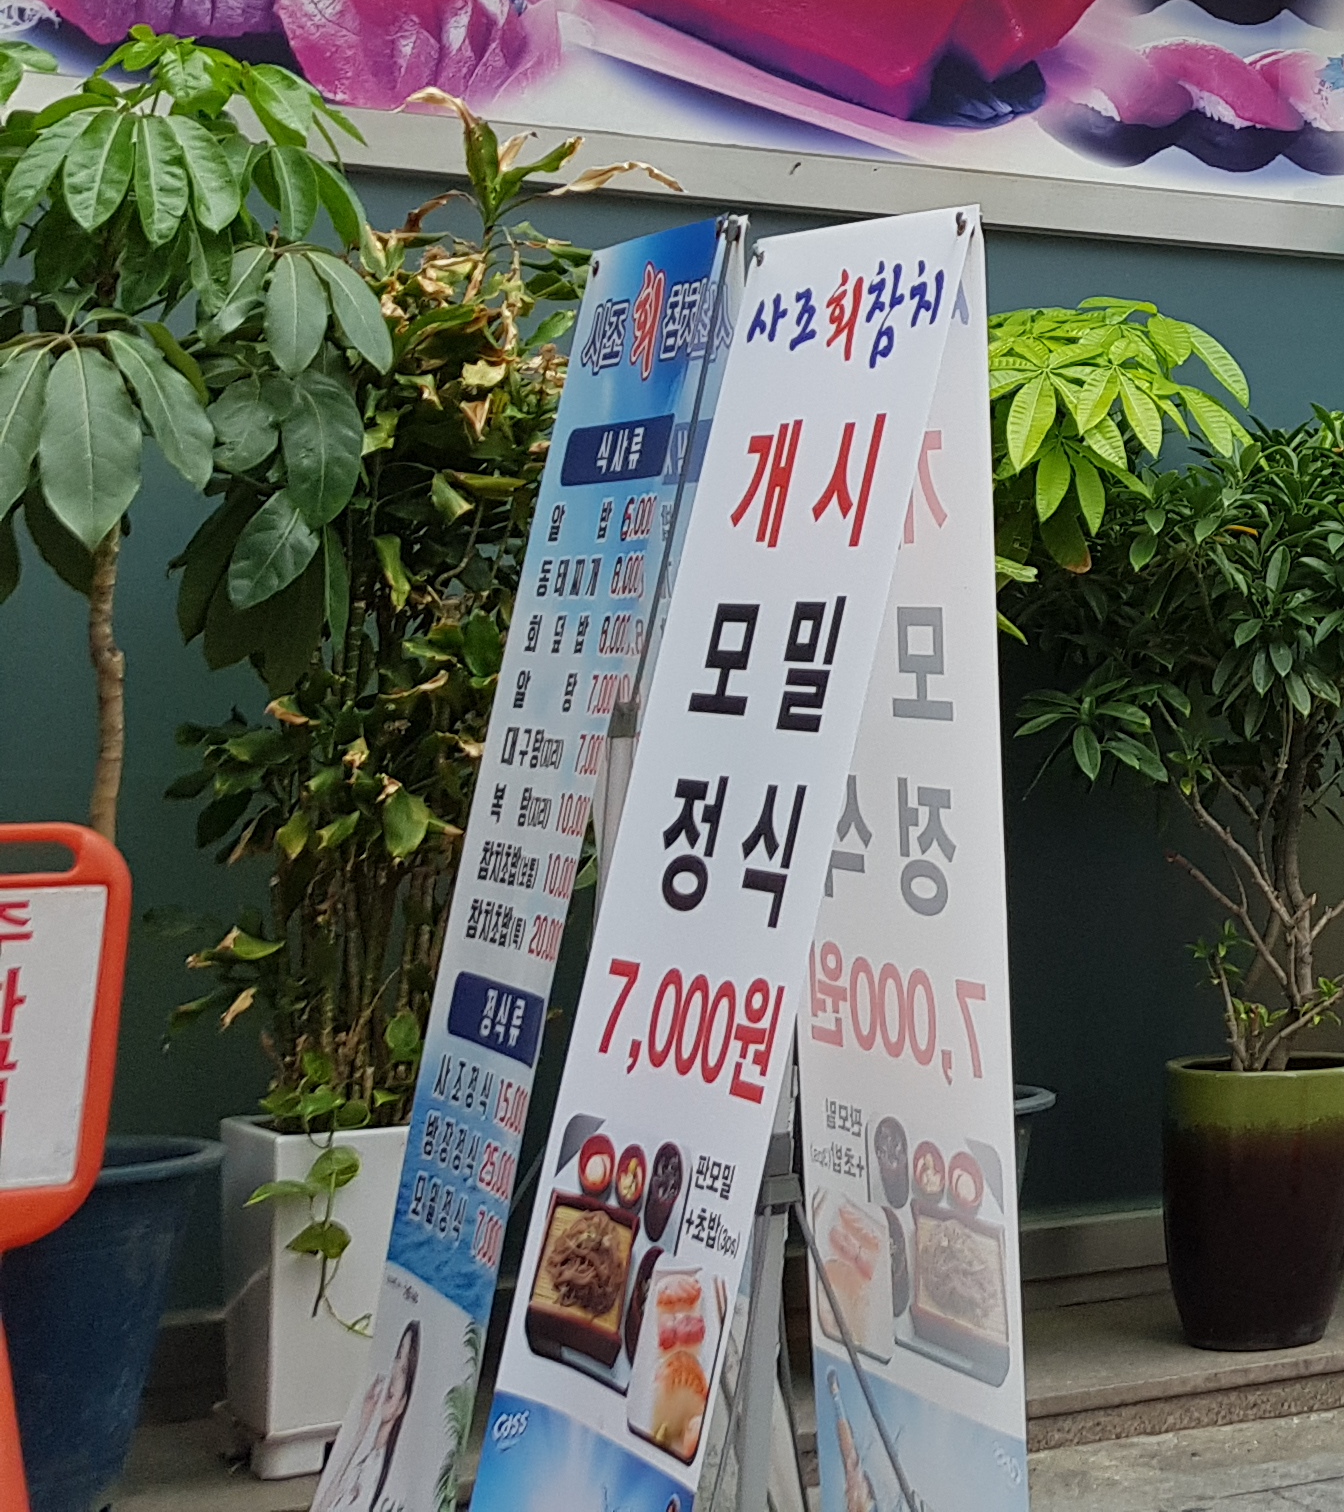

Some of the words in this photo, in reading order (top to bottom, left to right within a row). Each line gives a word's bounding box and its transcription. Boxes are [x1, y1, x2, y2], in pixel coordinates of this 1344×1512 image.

[746, 259, 946, 369] 사조회참치
[596, 426, 645, 475] 식사류
[730, 412, 887, 548] 개시
[687, 595, 848, 733] 모밀
[661, 774, 808, 930] 정식
[597, 956, 786, 1105] 7,000원
[695, 1154, 736, 1201] 판모밀
[684, 1207, 741, 1259] +초밥(3ps)
[492, 1408, 530, 1439] Cass
